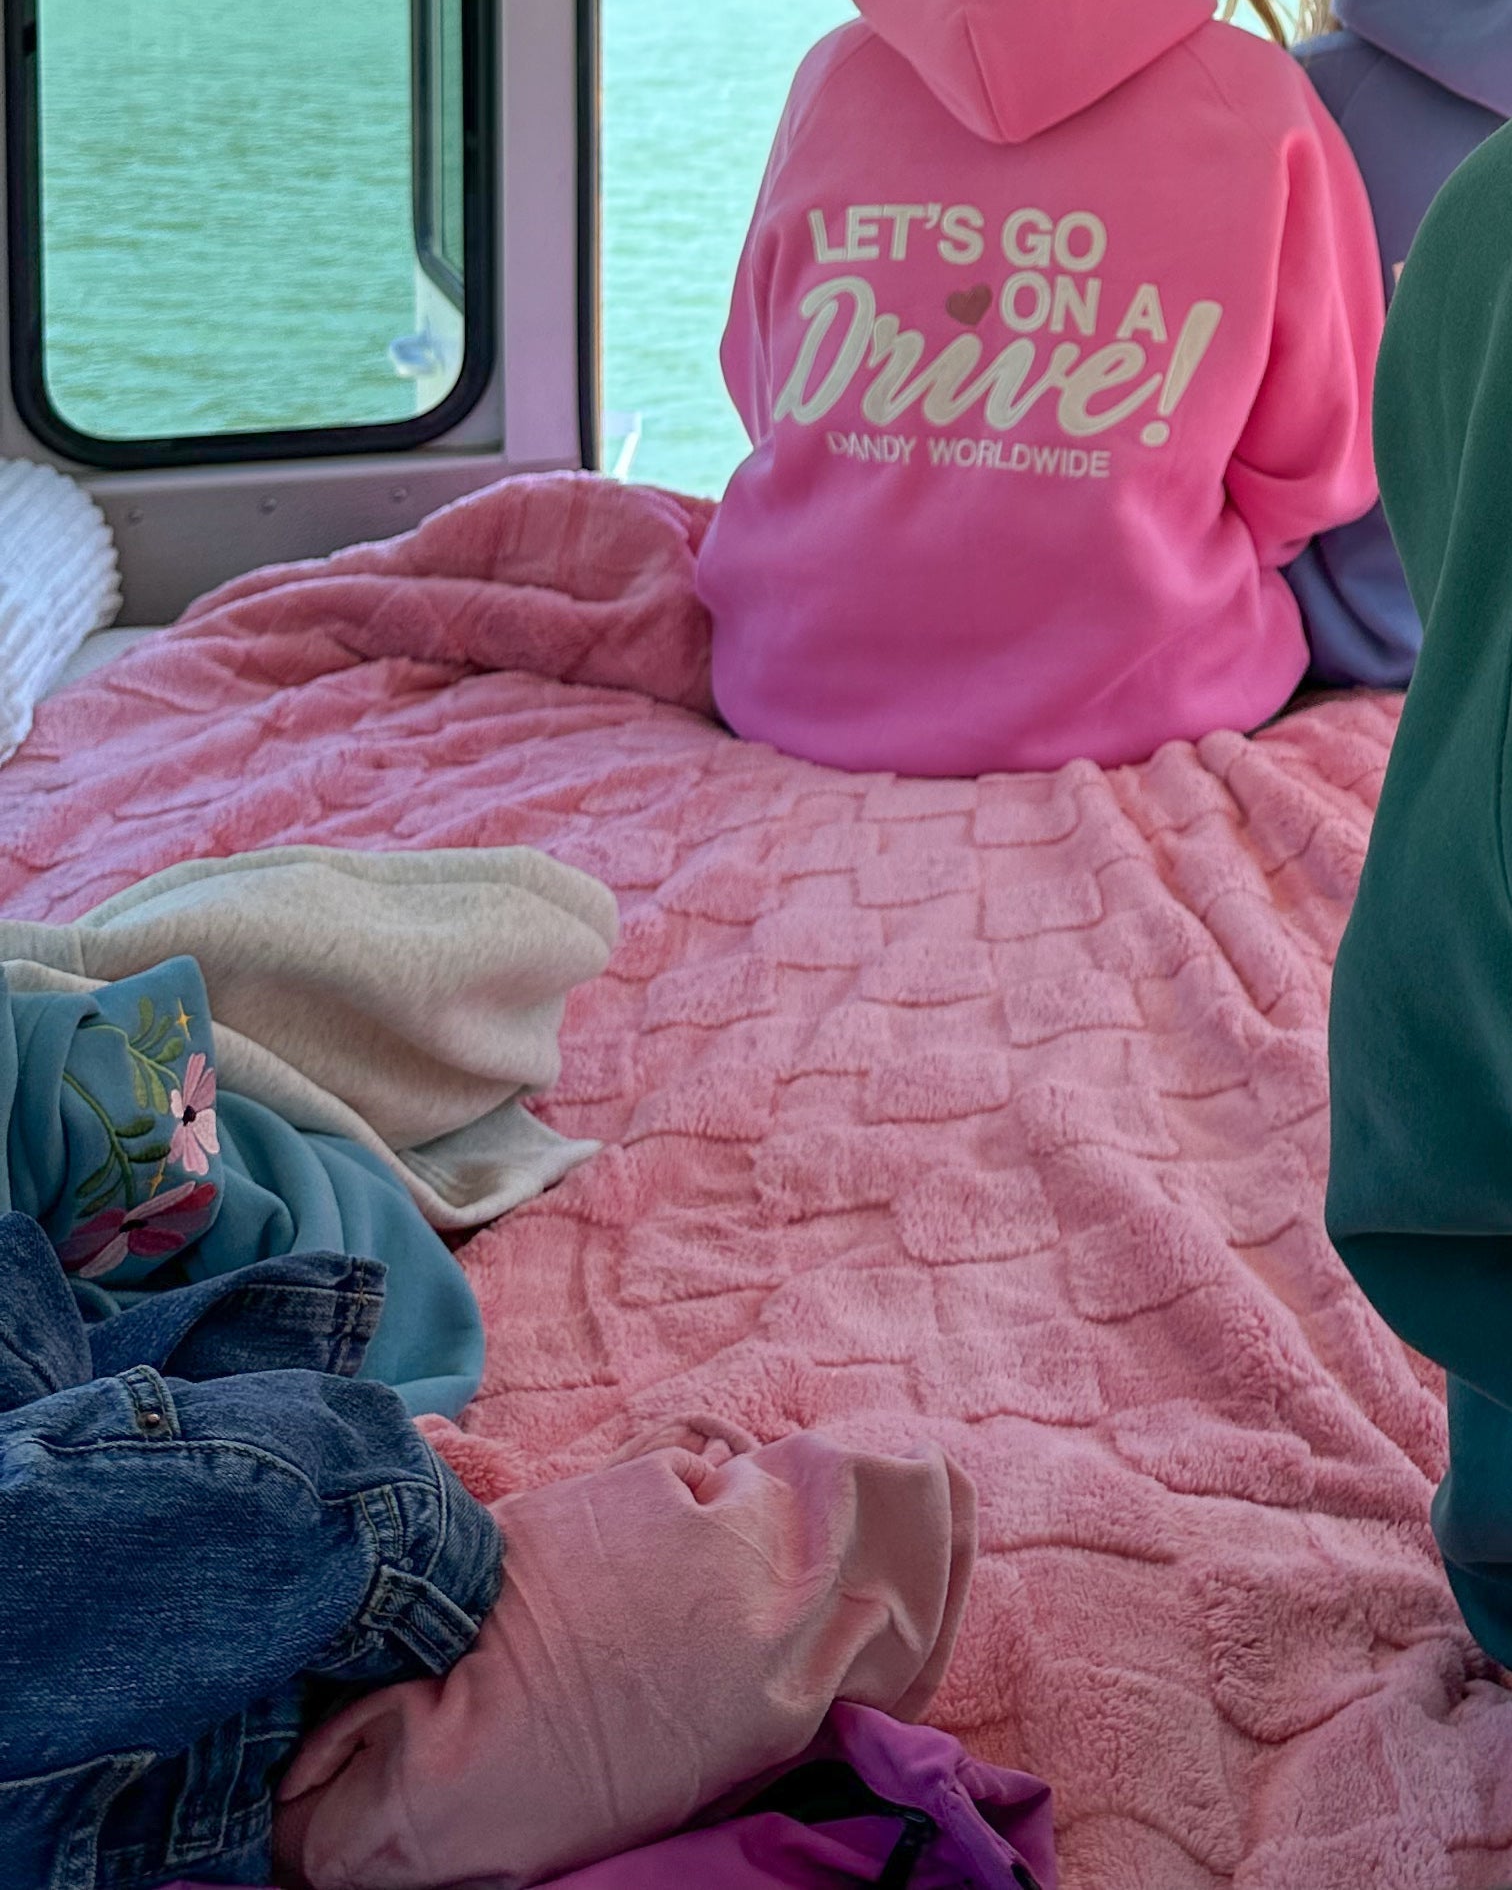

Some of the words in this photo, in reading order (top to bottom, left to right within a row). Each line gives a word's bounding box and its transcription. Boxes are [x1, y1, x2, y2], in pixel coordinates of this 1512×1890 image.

[807, 202, 984, 265] LET'S
[1001, 208, 1107, 271] GO
[1000, 271, 1102, 335] ON
[1117, 283, 1168, 343] A
[773, 275, 1223, 448] Drive!
[827, 430, 916, 466] DANDY
[928, 438, 1110, 479] WORLDWIDE
